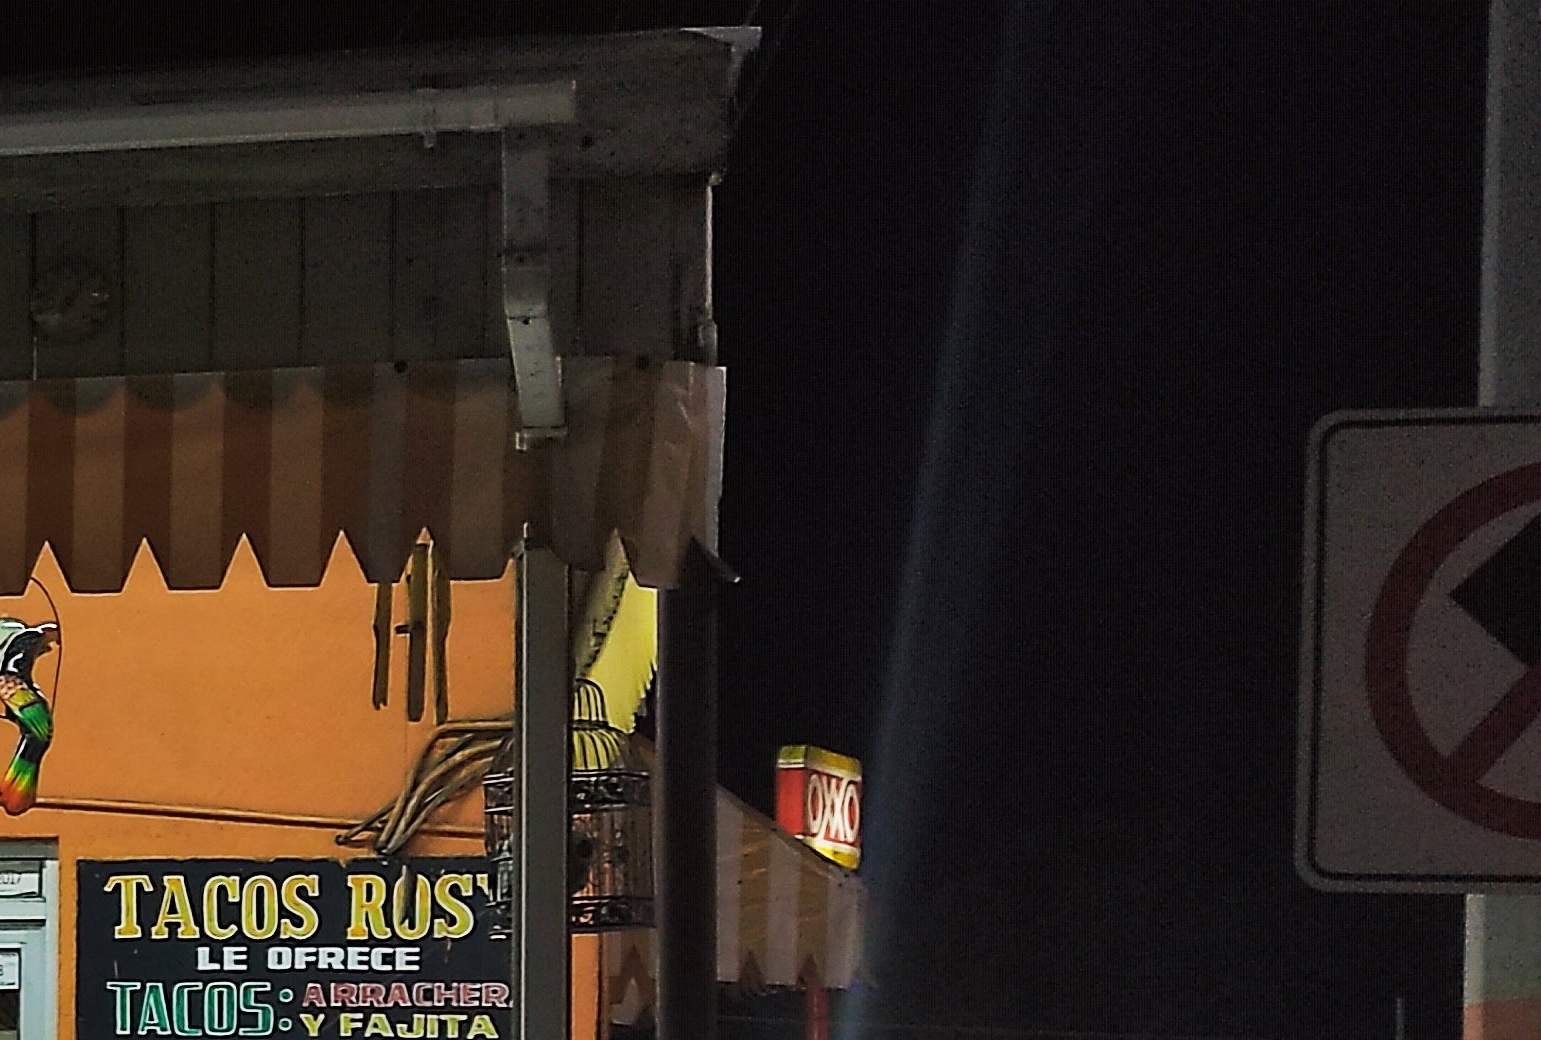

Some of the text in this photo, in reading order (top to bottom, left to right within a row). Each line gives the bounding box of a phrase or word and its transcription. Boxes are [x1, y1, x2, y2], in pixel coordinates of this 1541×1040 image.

[808, 774, 860, 843] OXXO
[104, 874, 319, 940] TACOS
[197, 946, 421, 972] LE OFRECE
[302, 982, 514, 1009] ARRACHER
[300, 1013, 499, 1040] Y FAJITA
